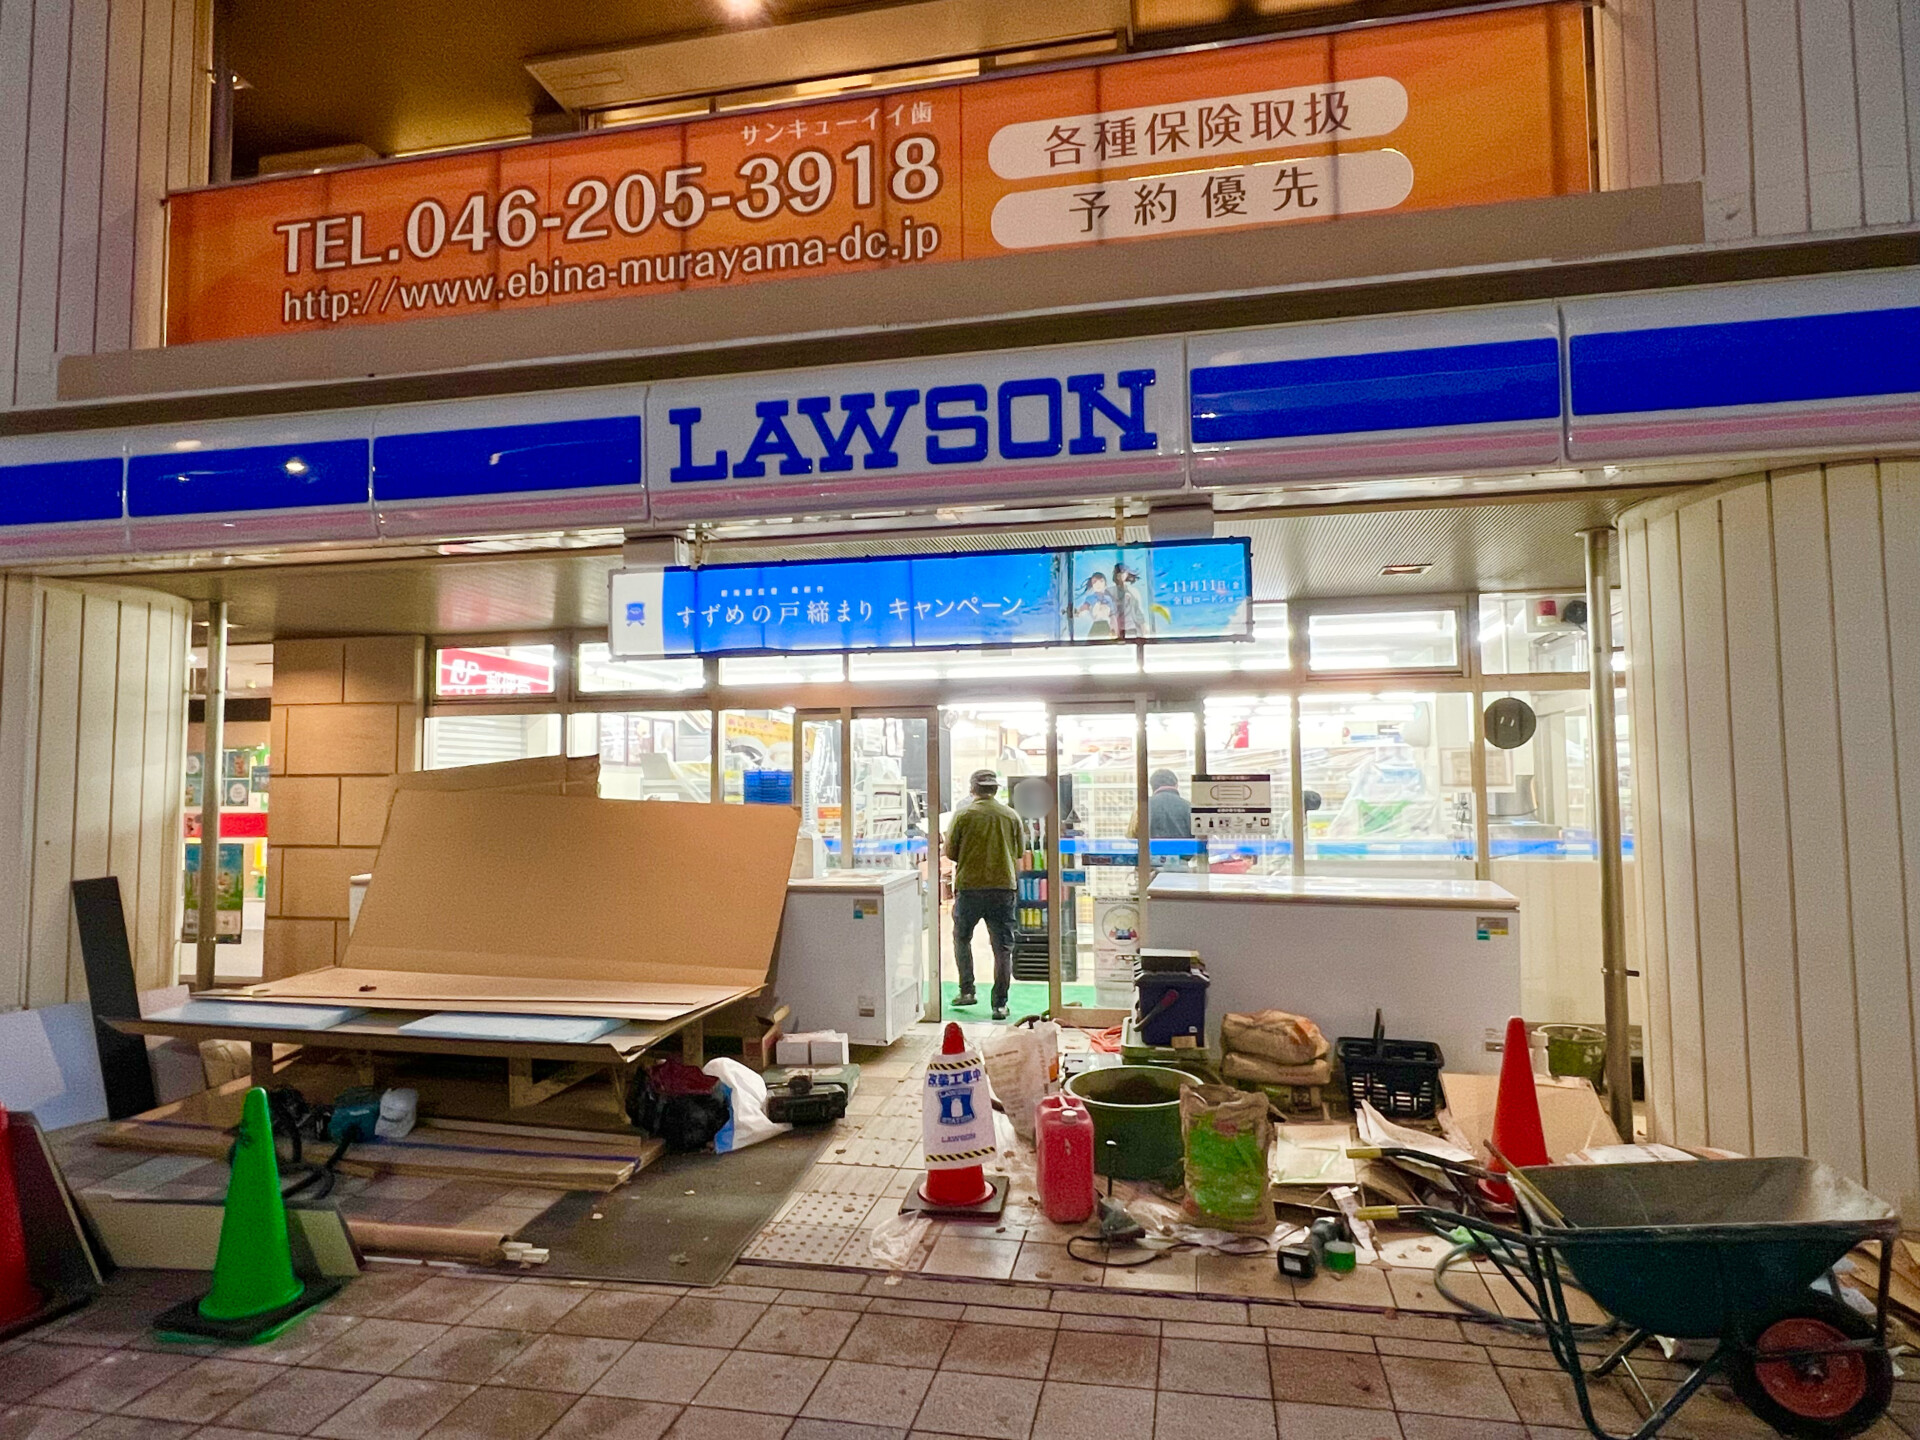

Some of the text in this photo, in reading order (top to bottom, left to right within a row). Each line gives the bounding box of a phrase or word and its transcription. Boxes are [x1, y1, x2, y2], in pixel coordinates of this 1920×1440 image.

[742, 101, 932, 146] サンキューイイ歯
[1043, 91, 1352, 167] 各種保険取扱
[277, 136, 940, 273] TEL.046-205-3918
[1069, 167, 1319, 233] 予約優先
[283, 218, 939, 323] http://www.ebina-murayama-dc.jp
[669, 369, 1157, 482] LAWSON
[677, 596, 1022, 629] すずめの戸締まり キャンペーン
